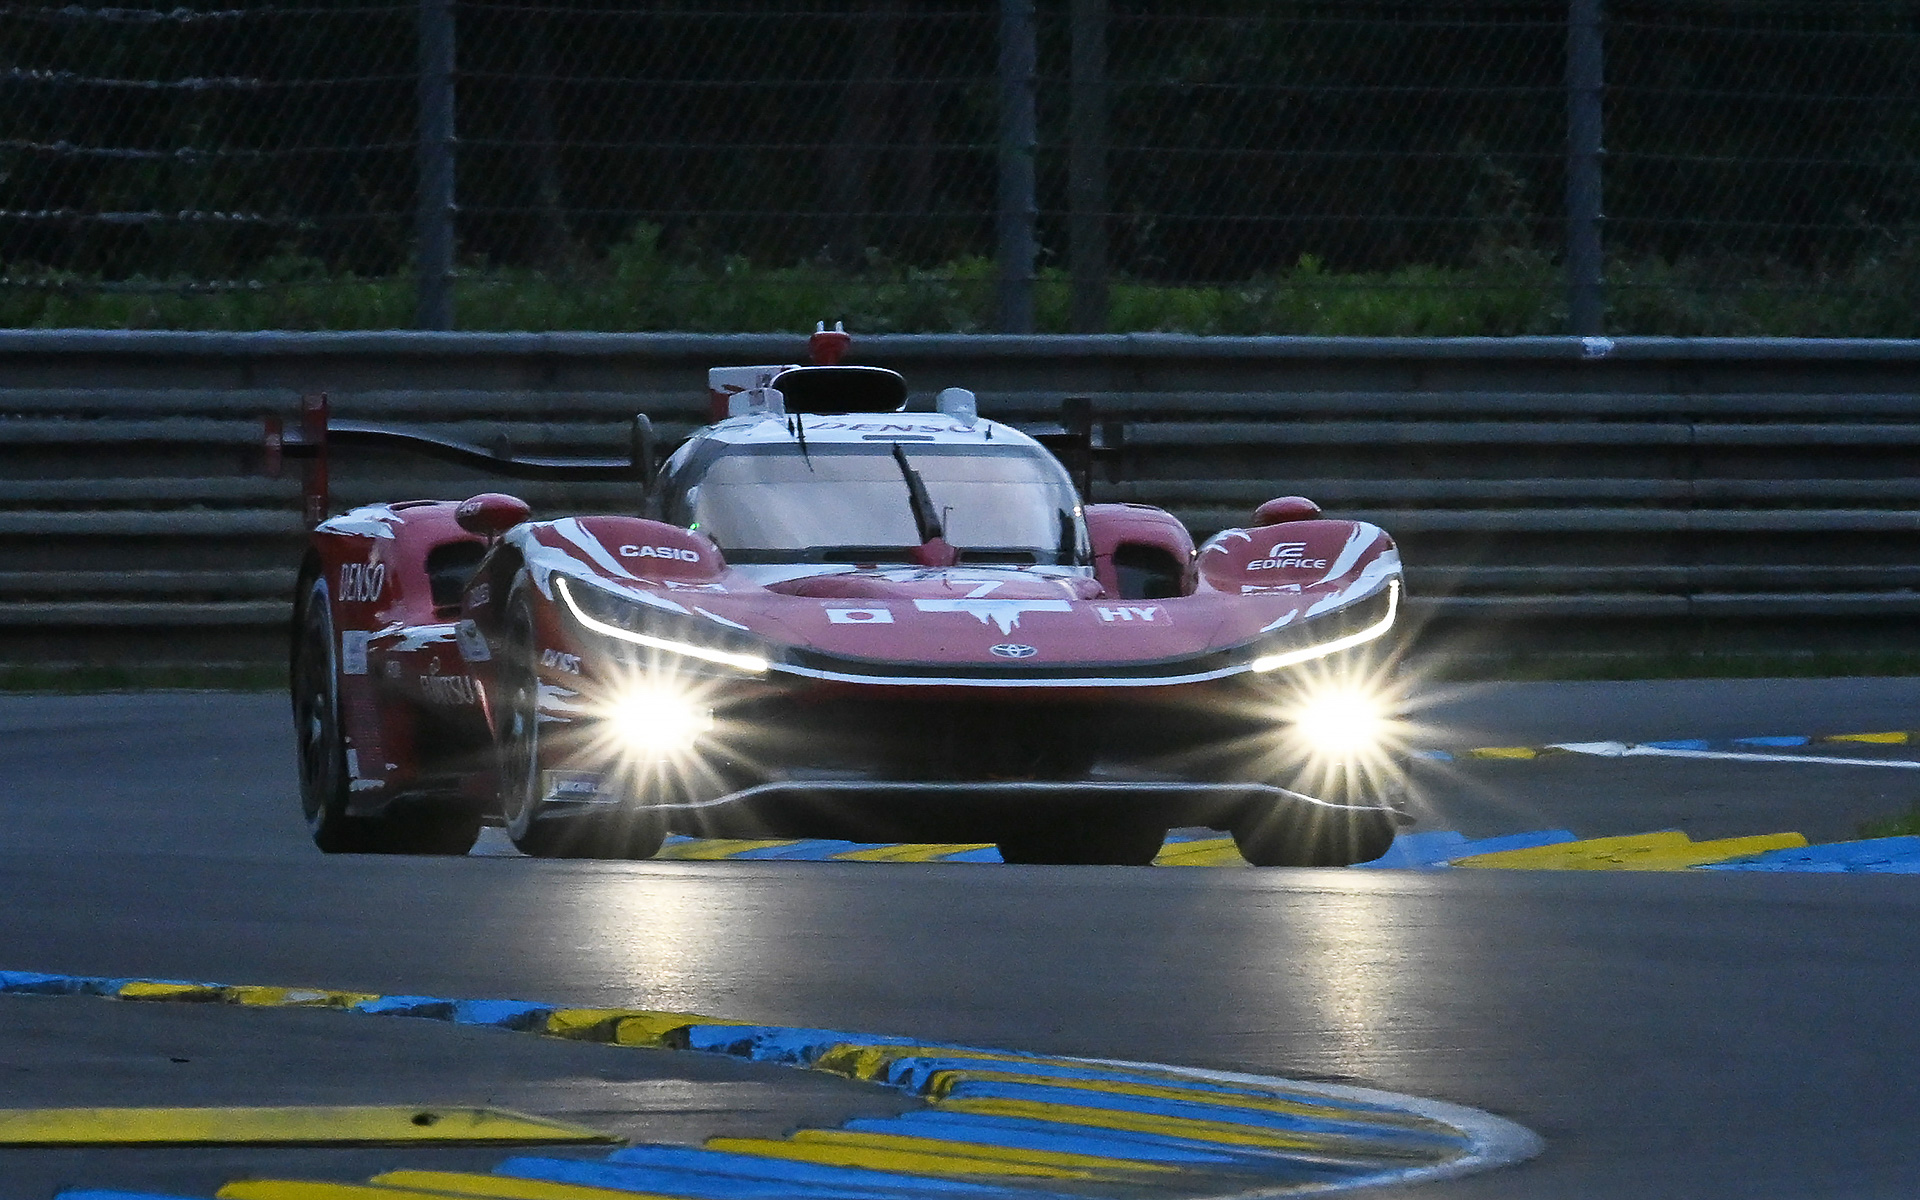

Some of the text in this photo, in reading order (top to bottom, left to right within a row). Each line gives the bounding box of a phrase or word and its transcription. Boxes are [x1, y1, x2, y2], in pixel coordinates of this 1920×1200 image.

[806, 422, 977, 434] DENSO
[619, 543, 700, 564] CASIO
[1246, 558, 1327, 571] EDIFICE
[338, 562, 385, 602] DENSO
[949, 580, 1006, 600] 7
[1098, 605, 1158, 623] HY
